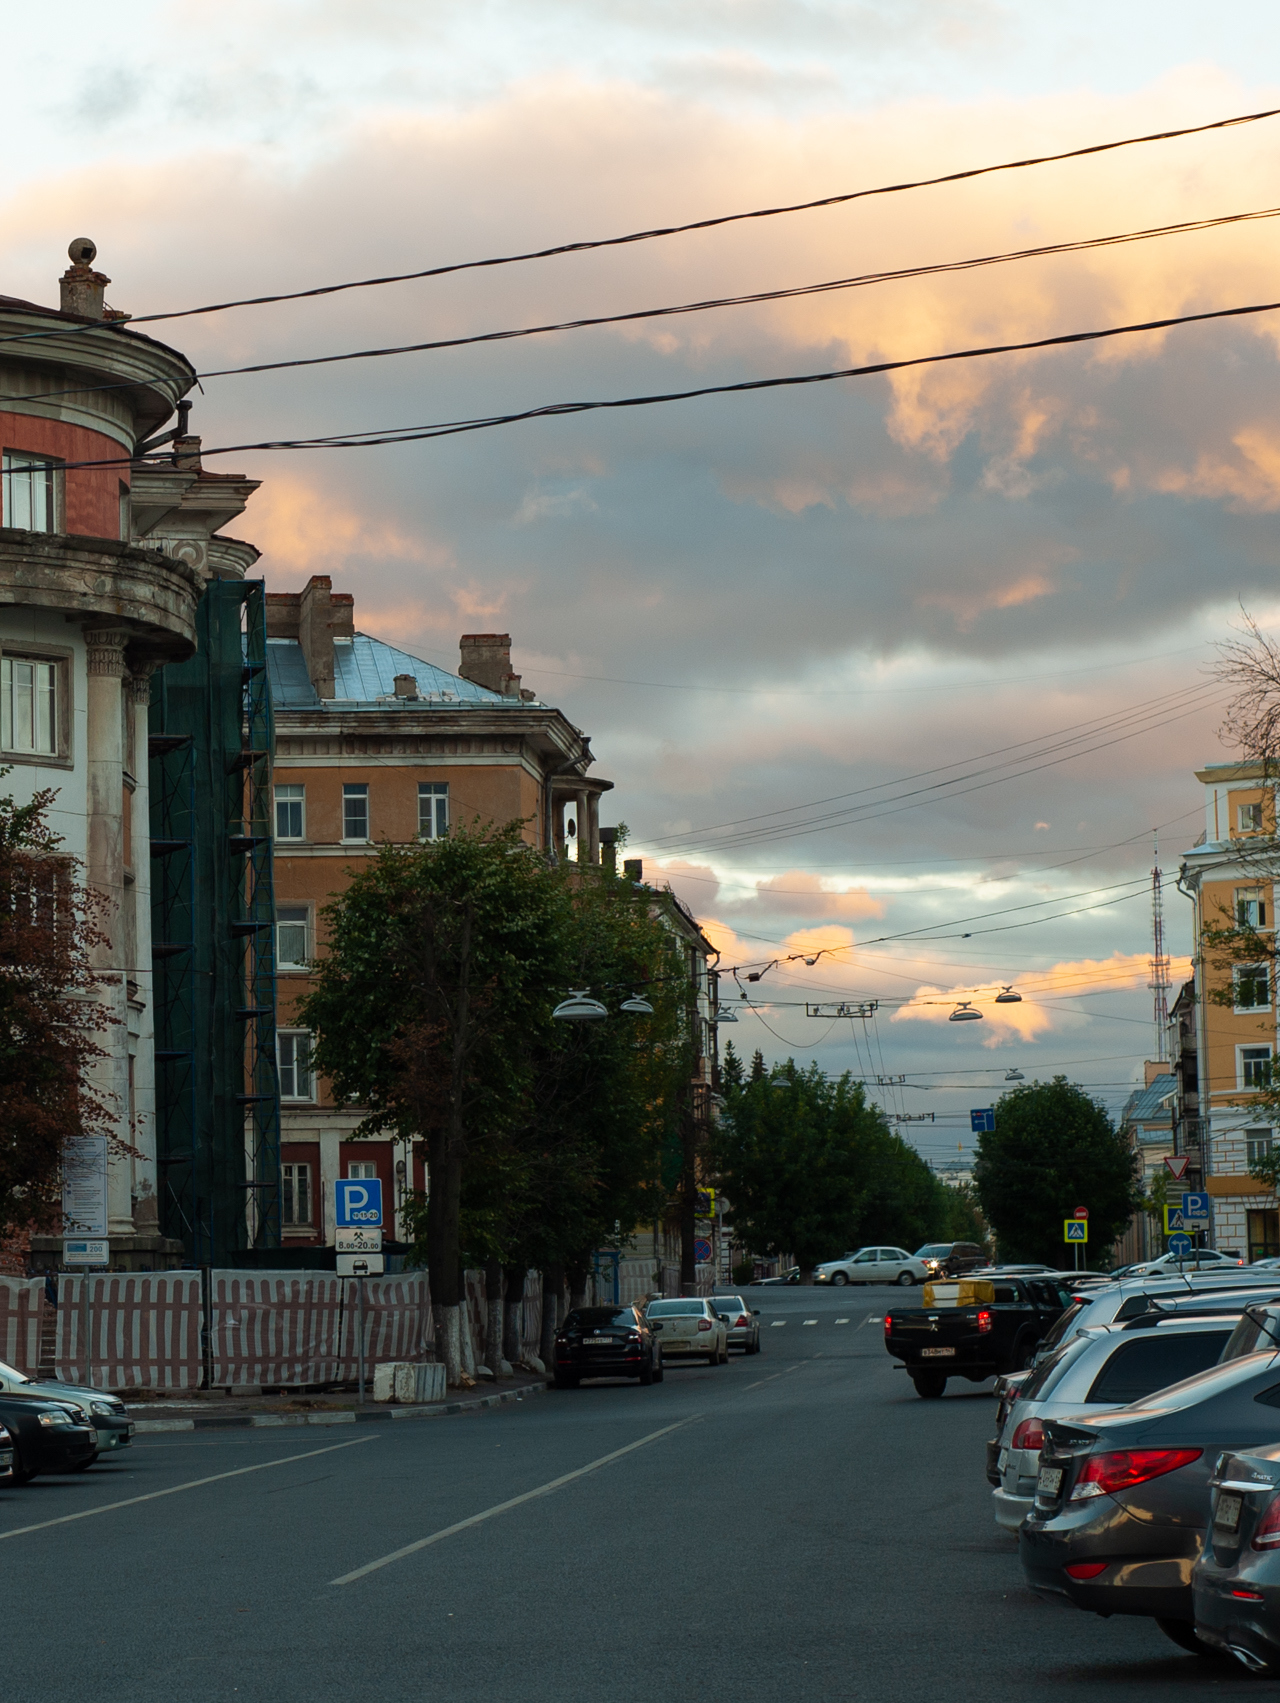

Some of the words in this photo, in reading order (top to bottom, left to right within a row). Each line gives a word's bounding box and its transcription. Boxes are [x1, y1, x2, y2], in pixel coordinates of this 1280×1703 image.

[343, 1185, 369, 1221] P
[1187, 1196, 1202, 1216] P
[369, 1211, 378, 1219] 20
[338, 1241, 379, 1250] 8.00-20.00
